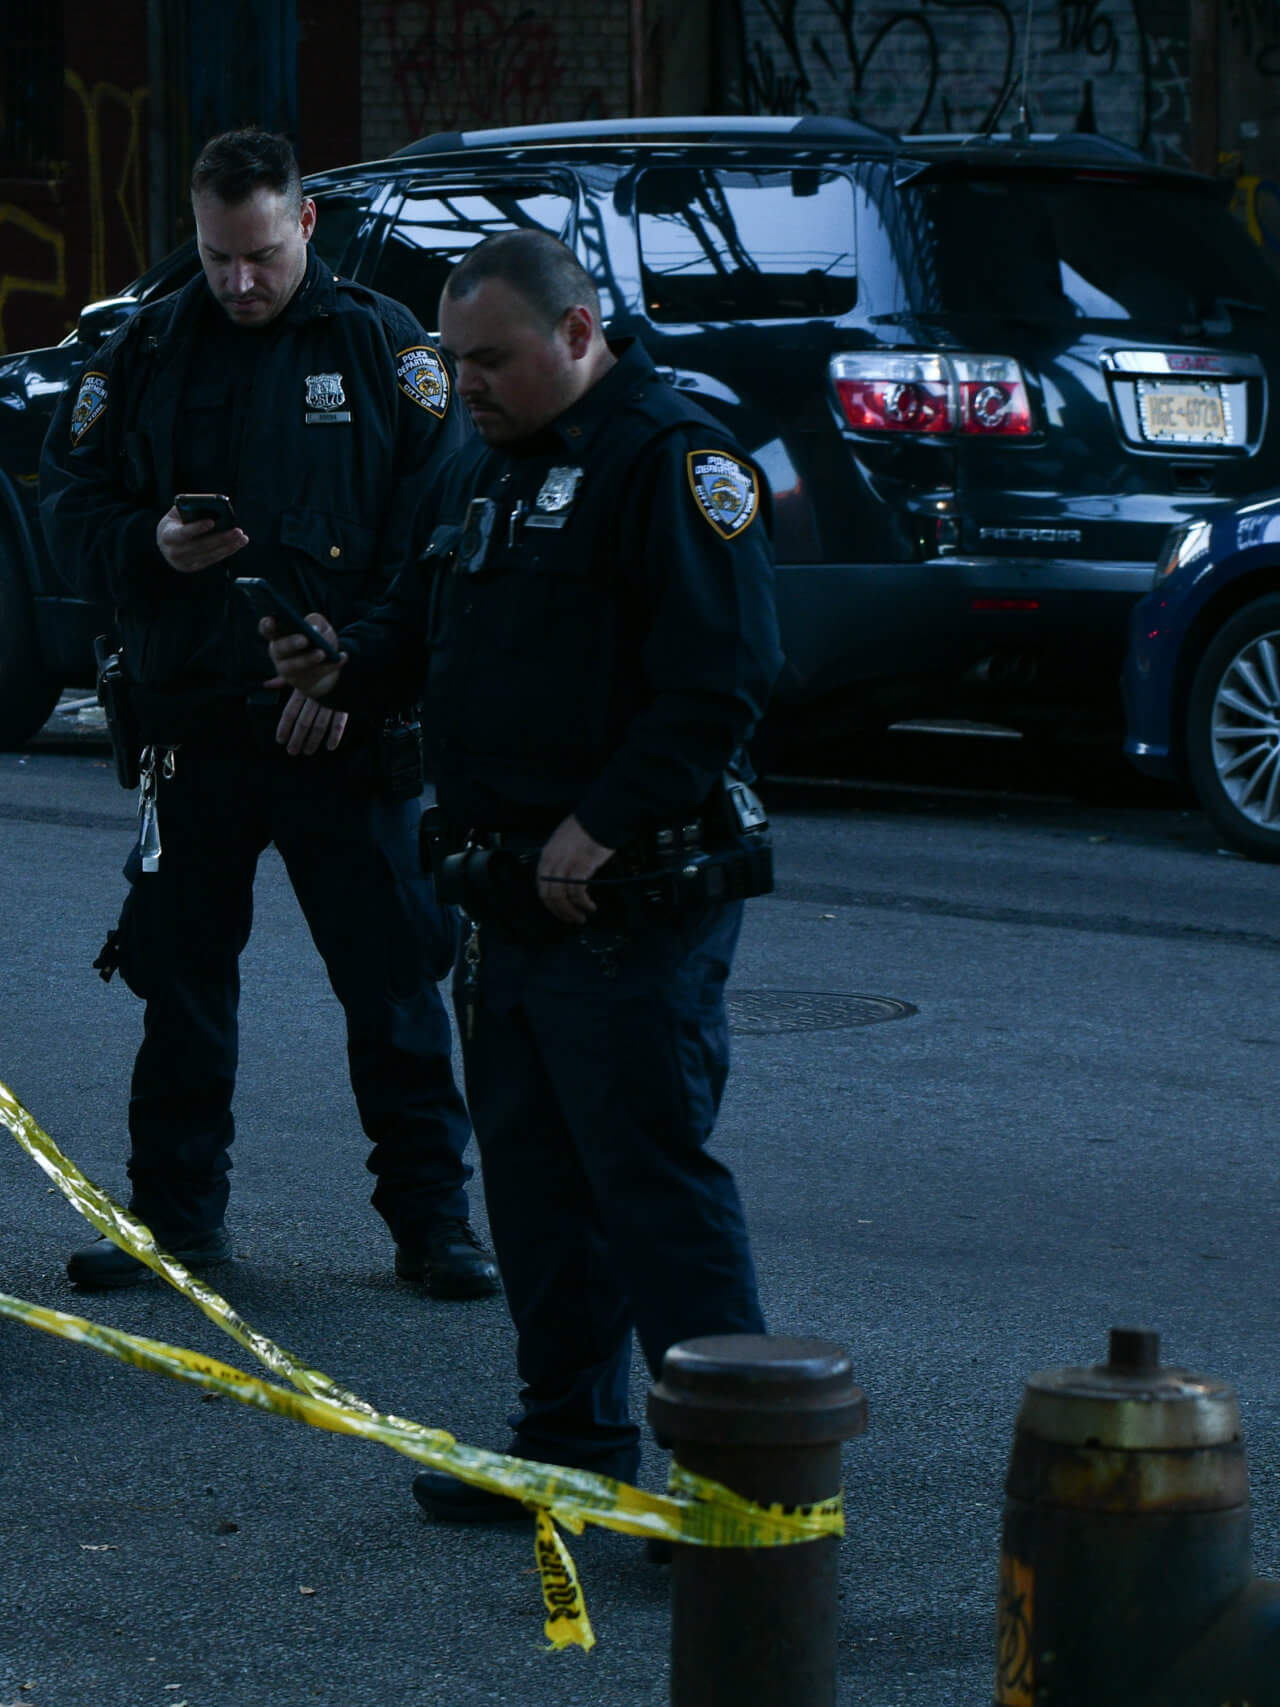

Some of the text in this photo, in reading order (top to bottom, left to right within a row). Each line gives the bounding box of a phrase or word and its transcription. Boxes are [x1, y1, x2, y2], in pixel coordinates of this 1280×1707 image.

[402, 350, 428, 363] POLICE
[1168, 355, 1221, 371] GMC
[397, 358, 439, 377] DEPARTMENT
[403, 384, 433, 409] CITY OF
[707, 455, 740, 471] POLICE
[695, 465, 752, 488] DEPARTMENT
